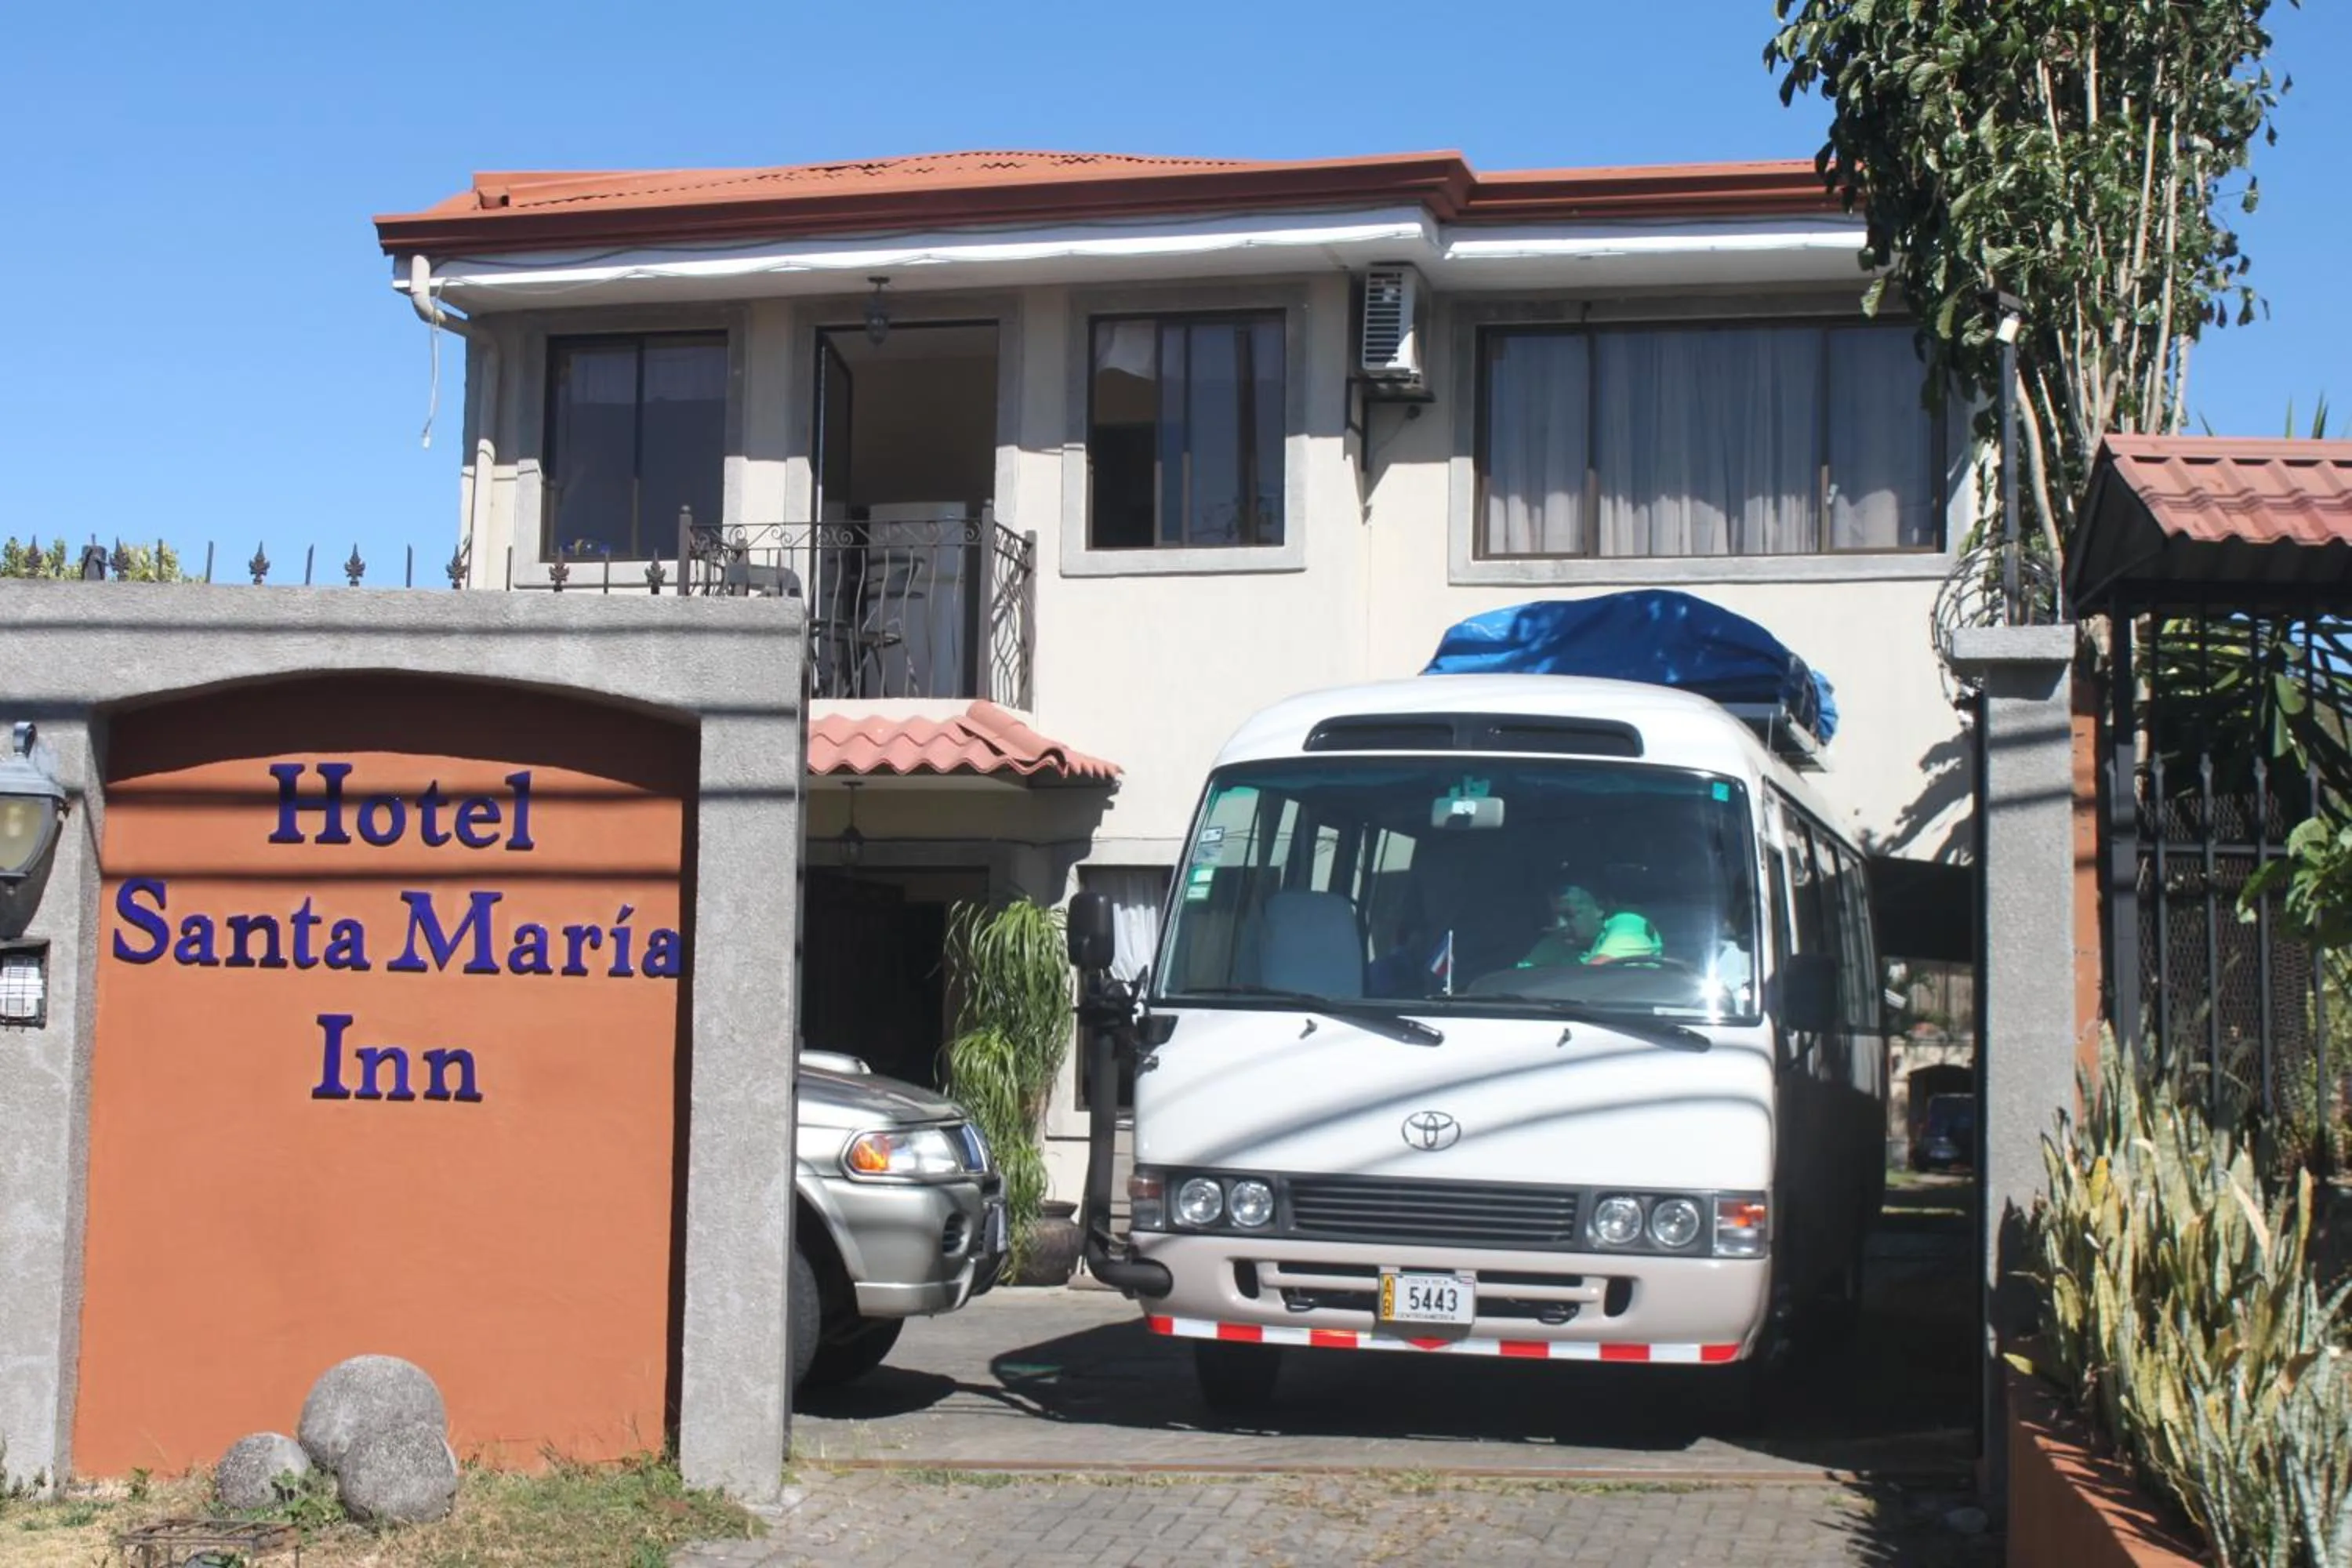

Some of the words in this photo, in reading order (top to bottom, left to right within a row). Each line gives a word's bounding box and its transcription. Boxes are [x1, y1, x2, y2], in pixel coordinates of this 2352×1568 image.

[269, 762, 535, 851] Hotel
[113, 877, 372, 971] Santa
[387, 891, 684, 979] María
[311, 1014, 484, 1103] Inn
[1409, 1286, 1458, 1312] 5443
